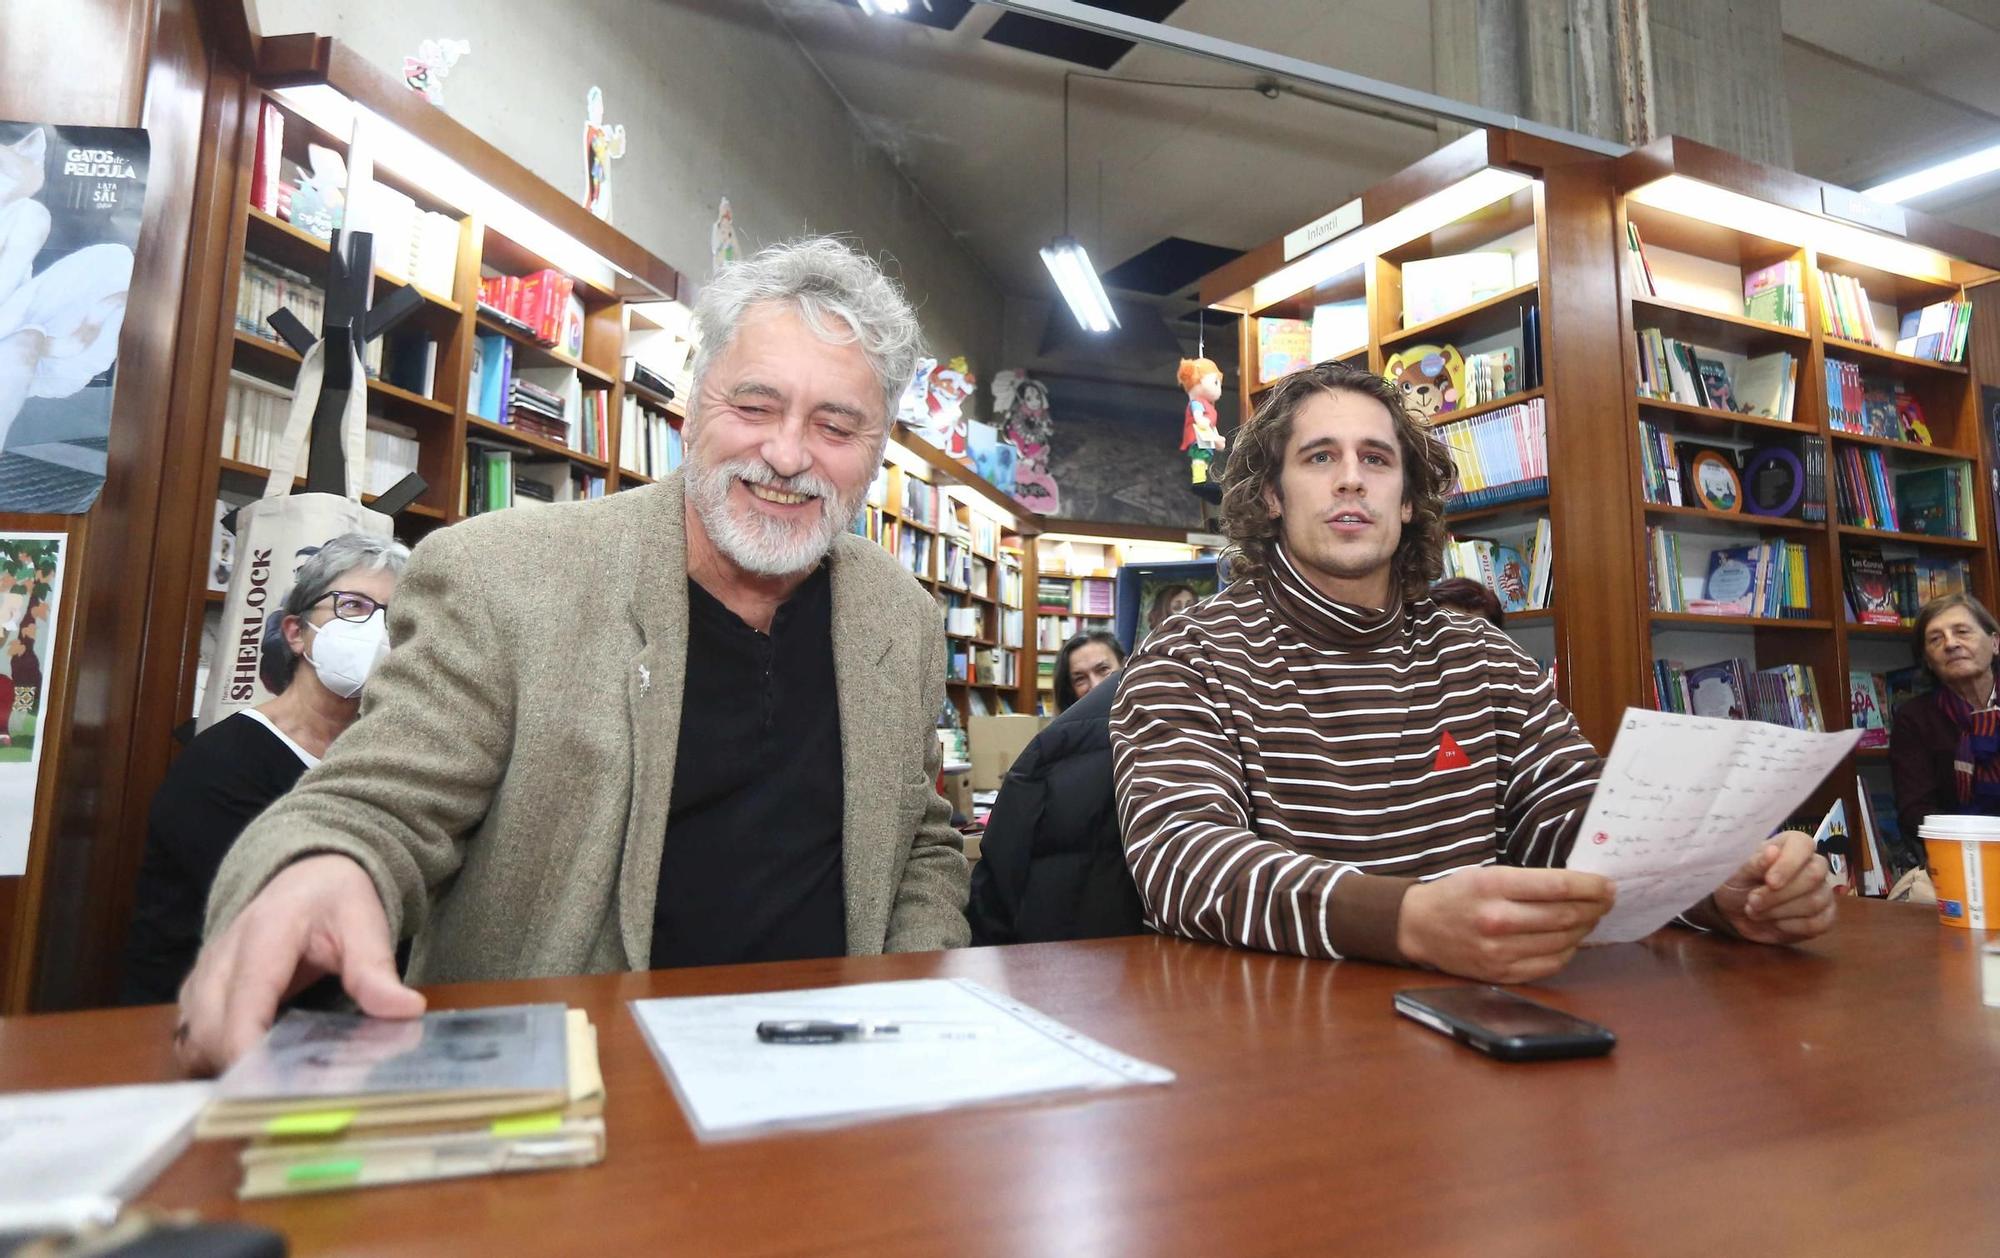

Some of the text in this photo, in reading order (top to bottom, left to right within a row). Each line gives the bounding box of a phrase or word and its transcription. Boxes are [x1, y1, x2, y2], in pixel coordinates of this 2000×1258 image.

[67, 149, 114, 163] GATOS
[97, 182, 117, 190] LATA
[93, 190, 117, 203] SAL
[1307, 215, 1338, 241] Infantil
[231, 548, 273, 701] SHERLOCK
